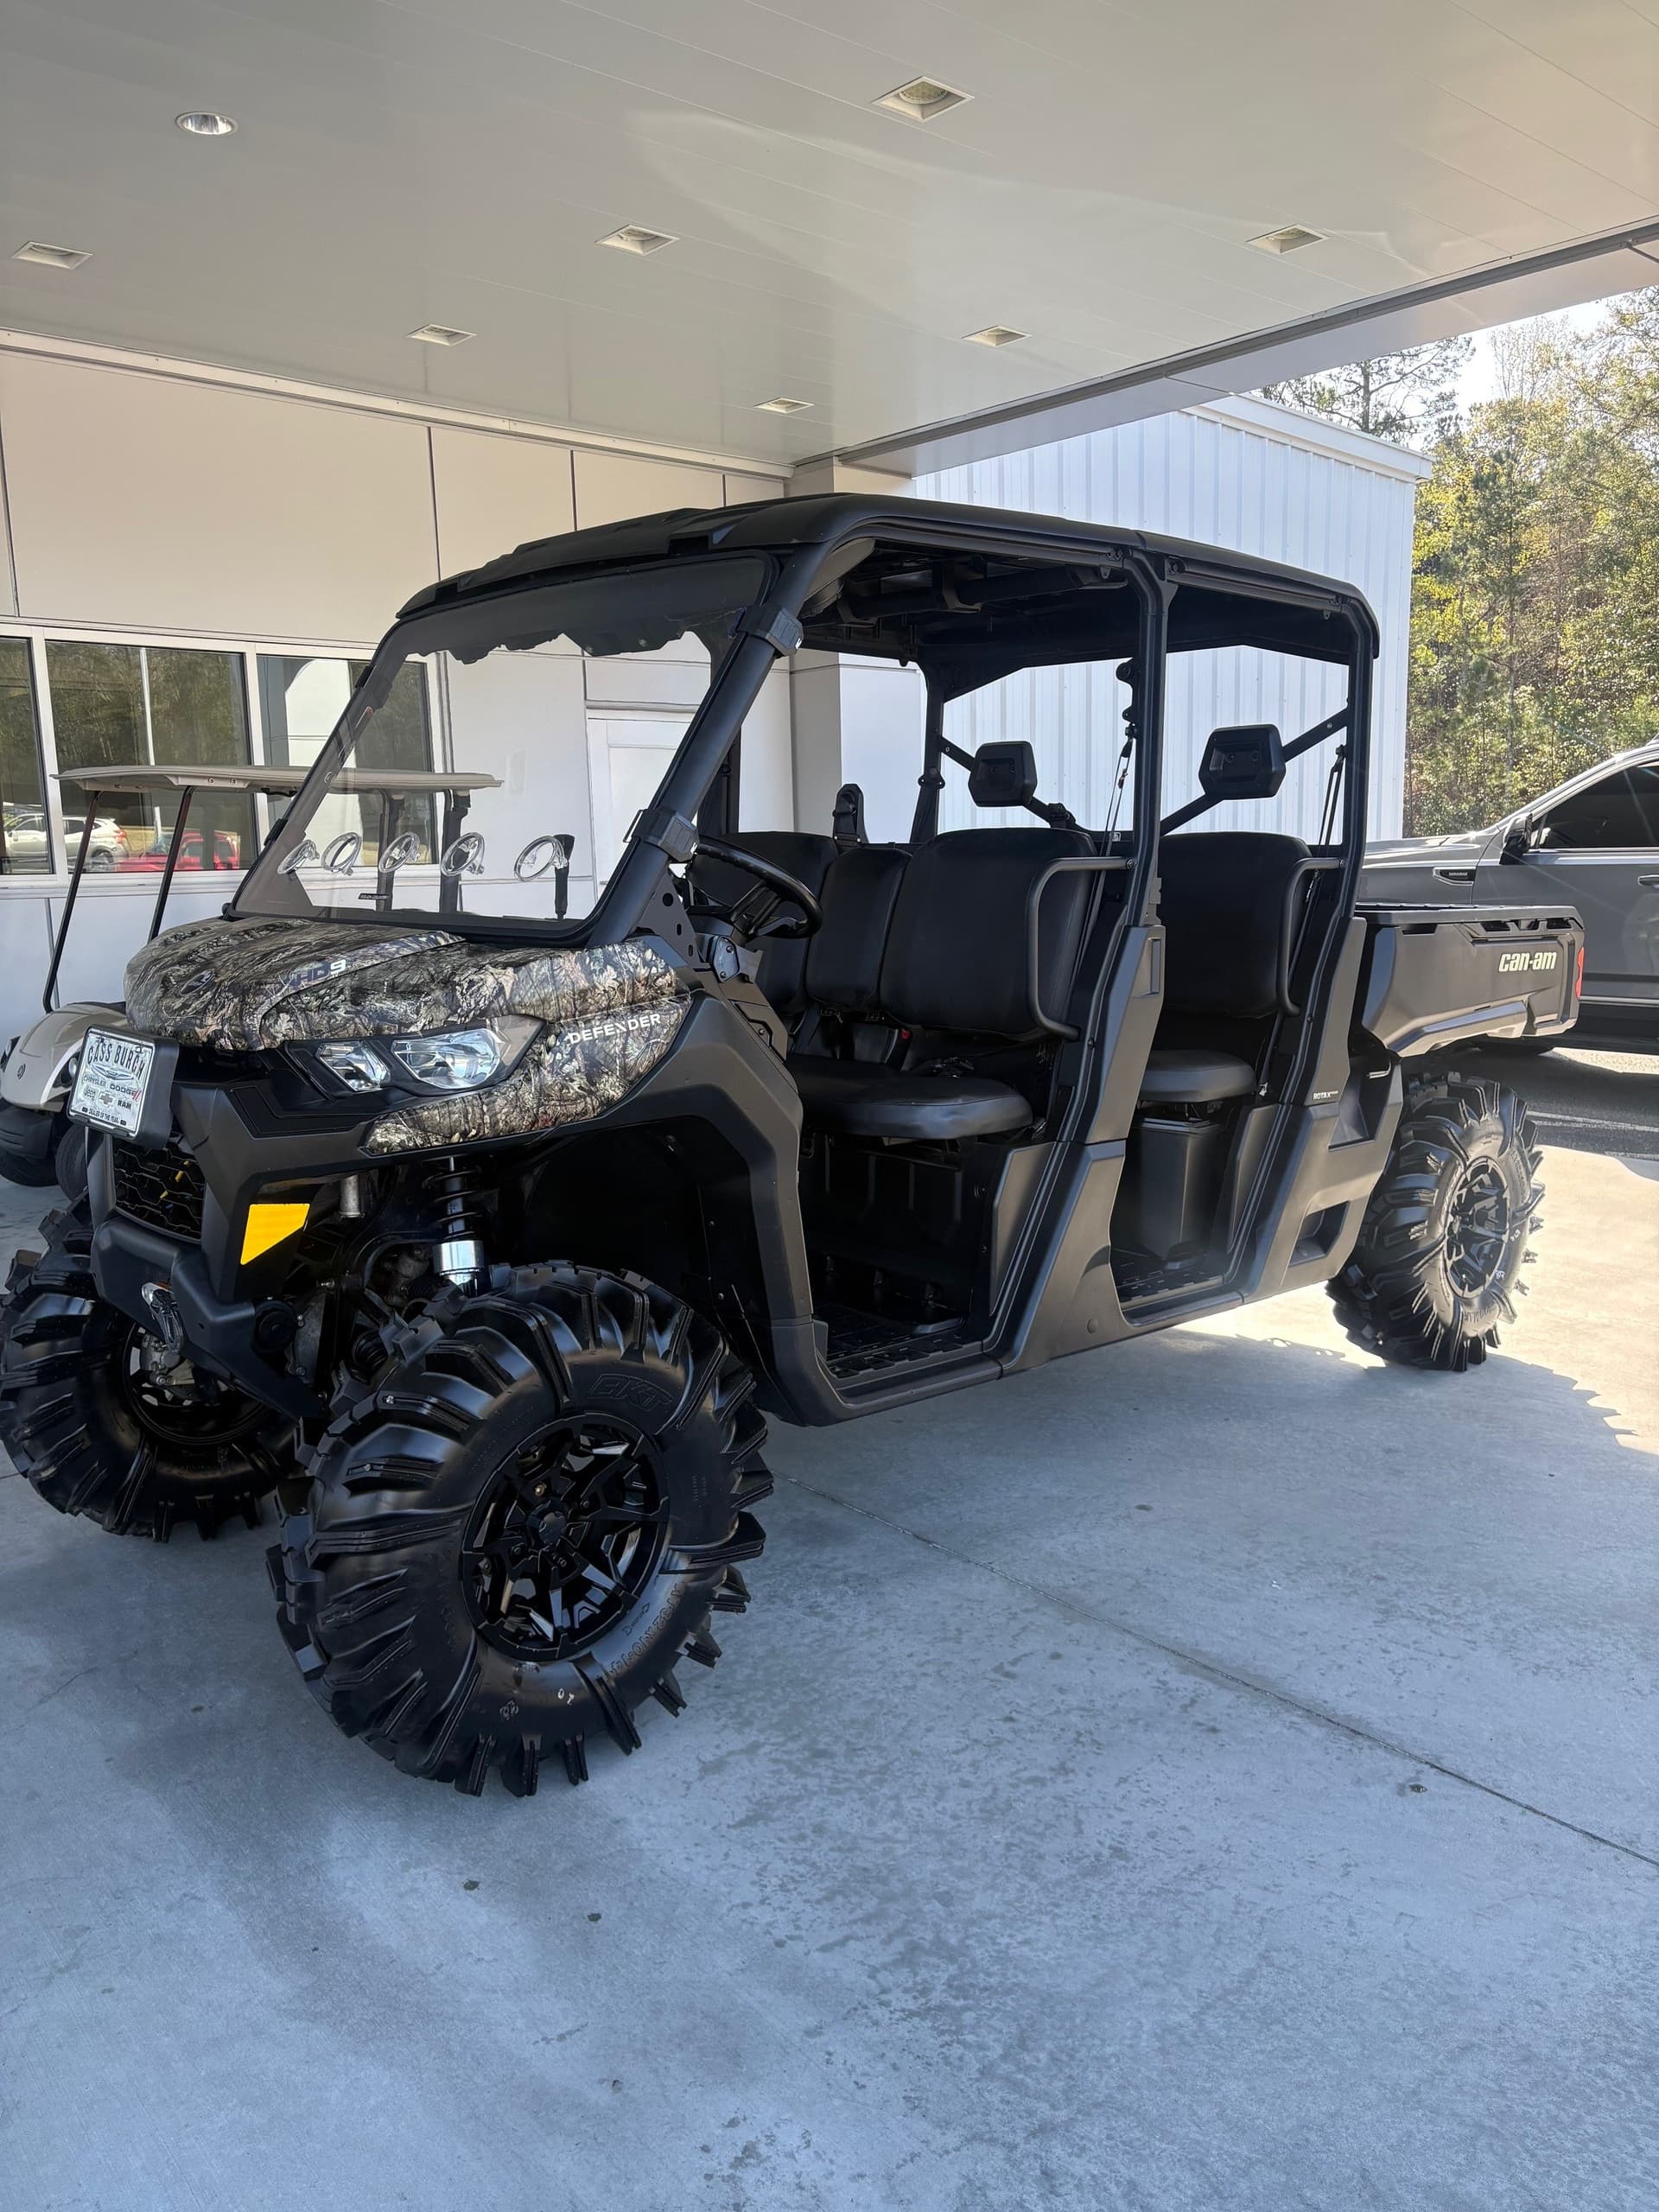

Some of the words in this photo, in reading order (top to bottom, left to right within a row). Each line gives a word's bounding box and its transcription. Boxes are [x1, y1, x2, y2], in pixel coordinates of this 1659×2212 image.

[1497, 951, 1557, 972] can-am
[569, 1014, 661, 1044] DEFENDER
[87, 1043, 111, 1065] CASS
[114, 1045, 145, 1080] BURCH
[110, 1084, 137, 1096] DODGE
[117, 1099, 132, 1110] RAM
